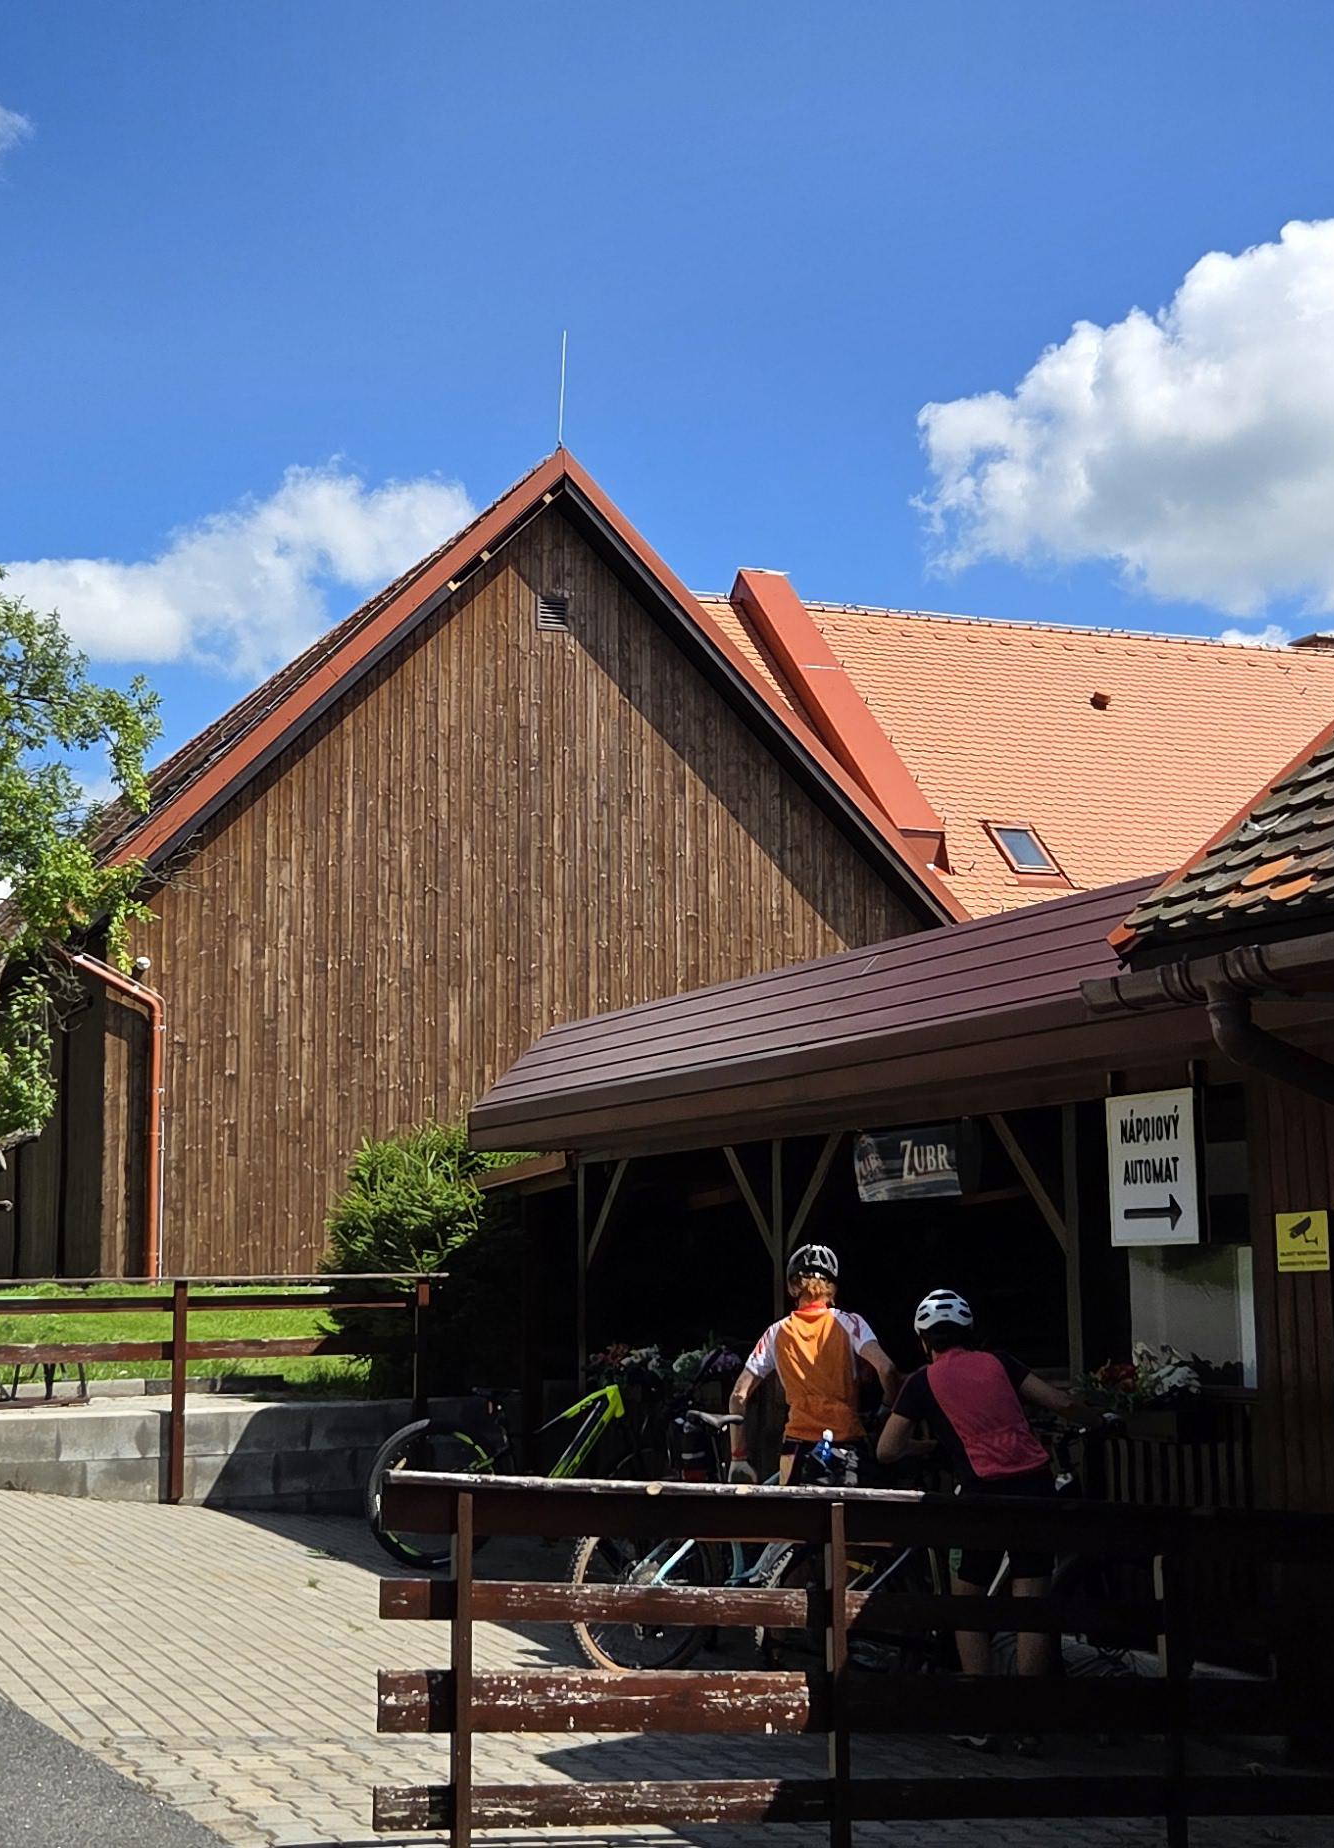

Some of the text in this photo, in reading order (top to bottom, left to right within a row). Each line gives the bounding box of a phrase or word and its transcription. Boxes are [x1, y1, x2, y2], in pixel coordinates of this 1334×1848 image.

[1120, 1105, 1179, 1145] NÁPOJOVÝ
[899, 1140, 952, 1180] ZUBR
[1123, 1156, 1179, 1186] AUTOMAT
